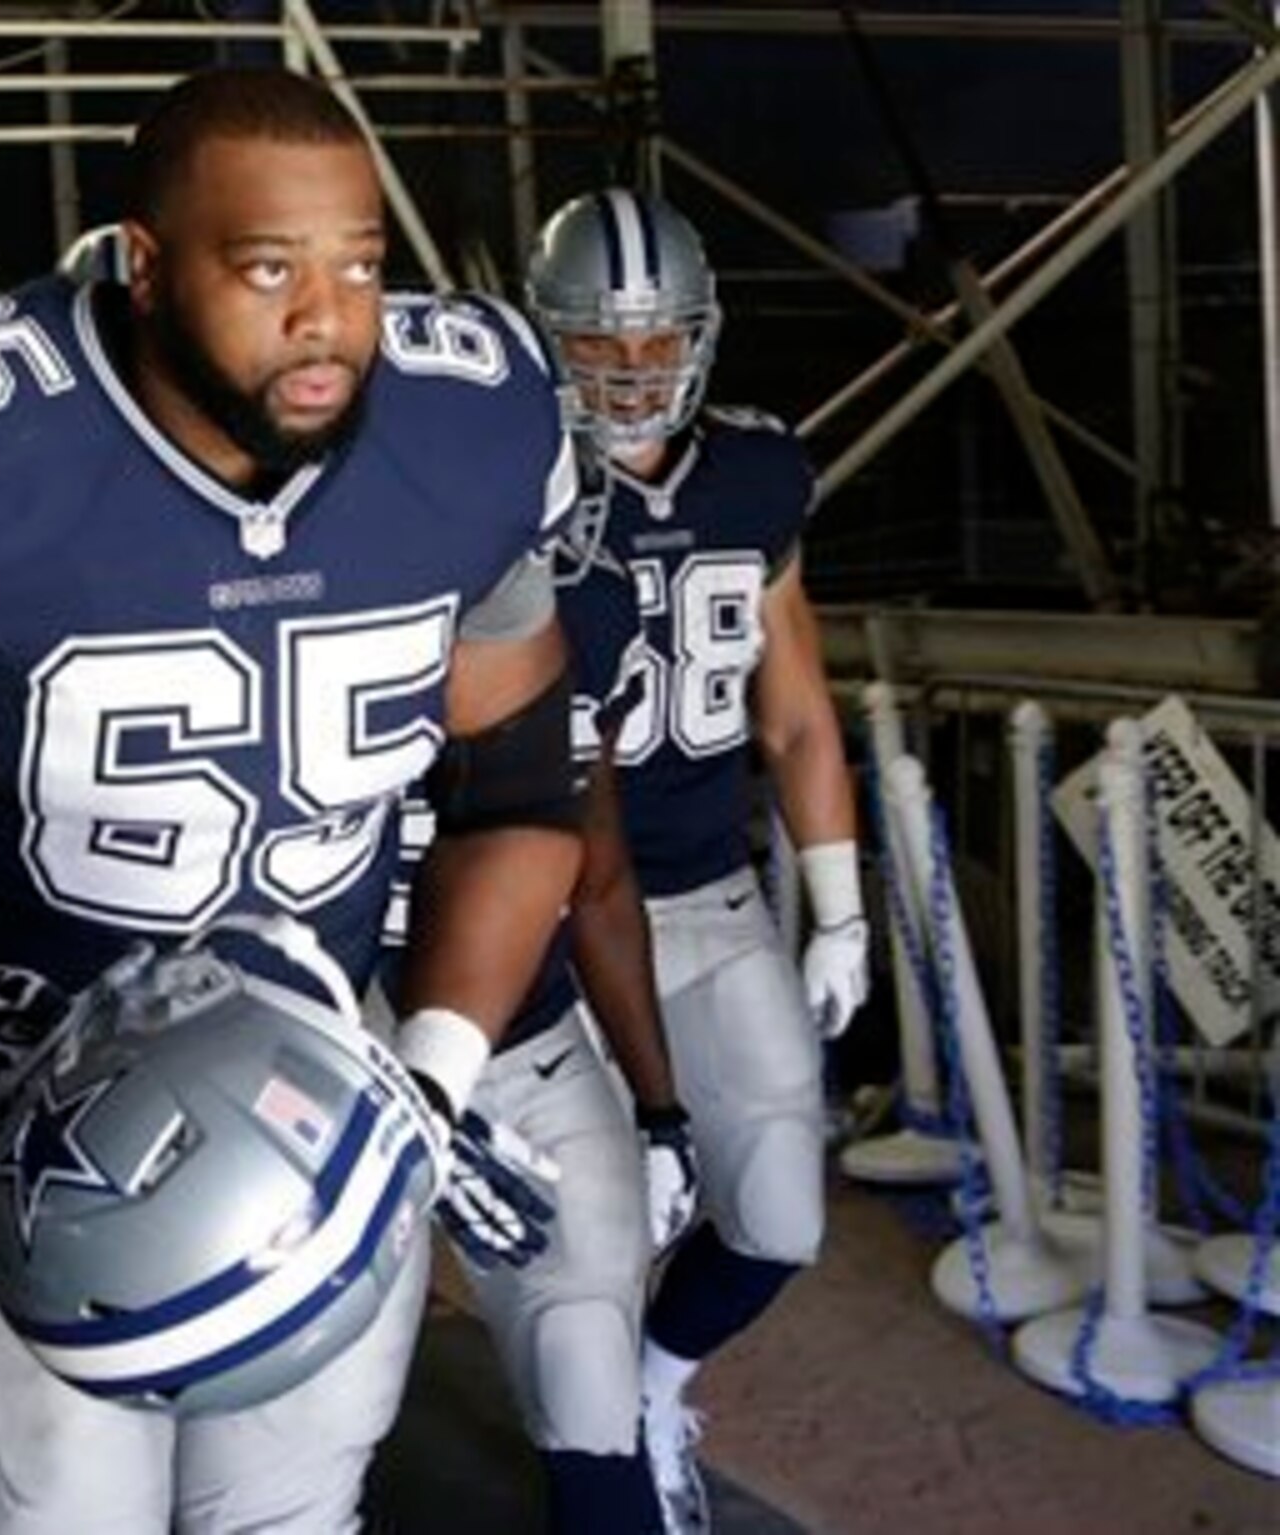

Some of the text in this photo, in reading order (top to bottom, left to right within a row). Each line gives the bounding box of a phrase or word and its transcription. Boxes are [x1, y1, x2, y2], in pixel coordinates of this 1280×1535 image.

[20, 593, 460, 933] 65
[1167, 788, 1231, 848] OFF
[1198, 831, 1257, 897] THE
